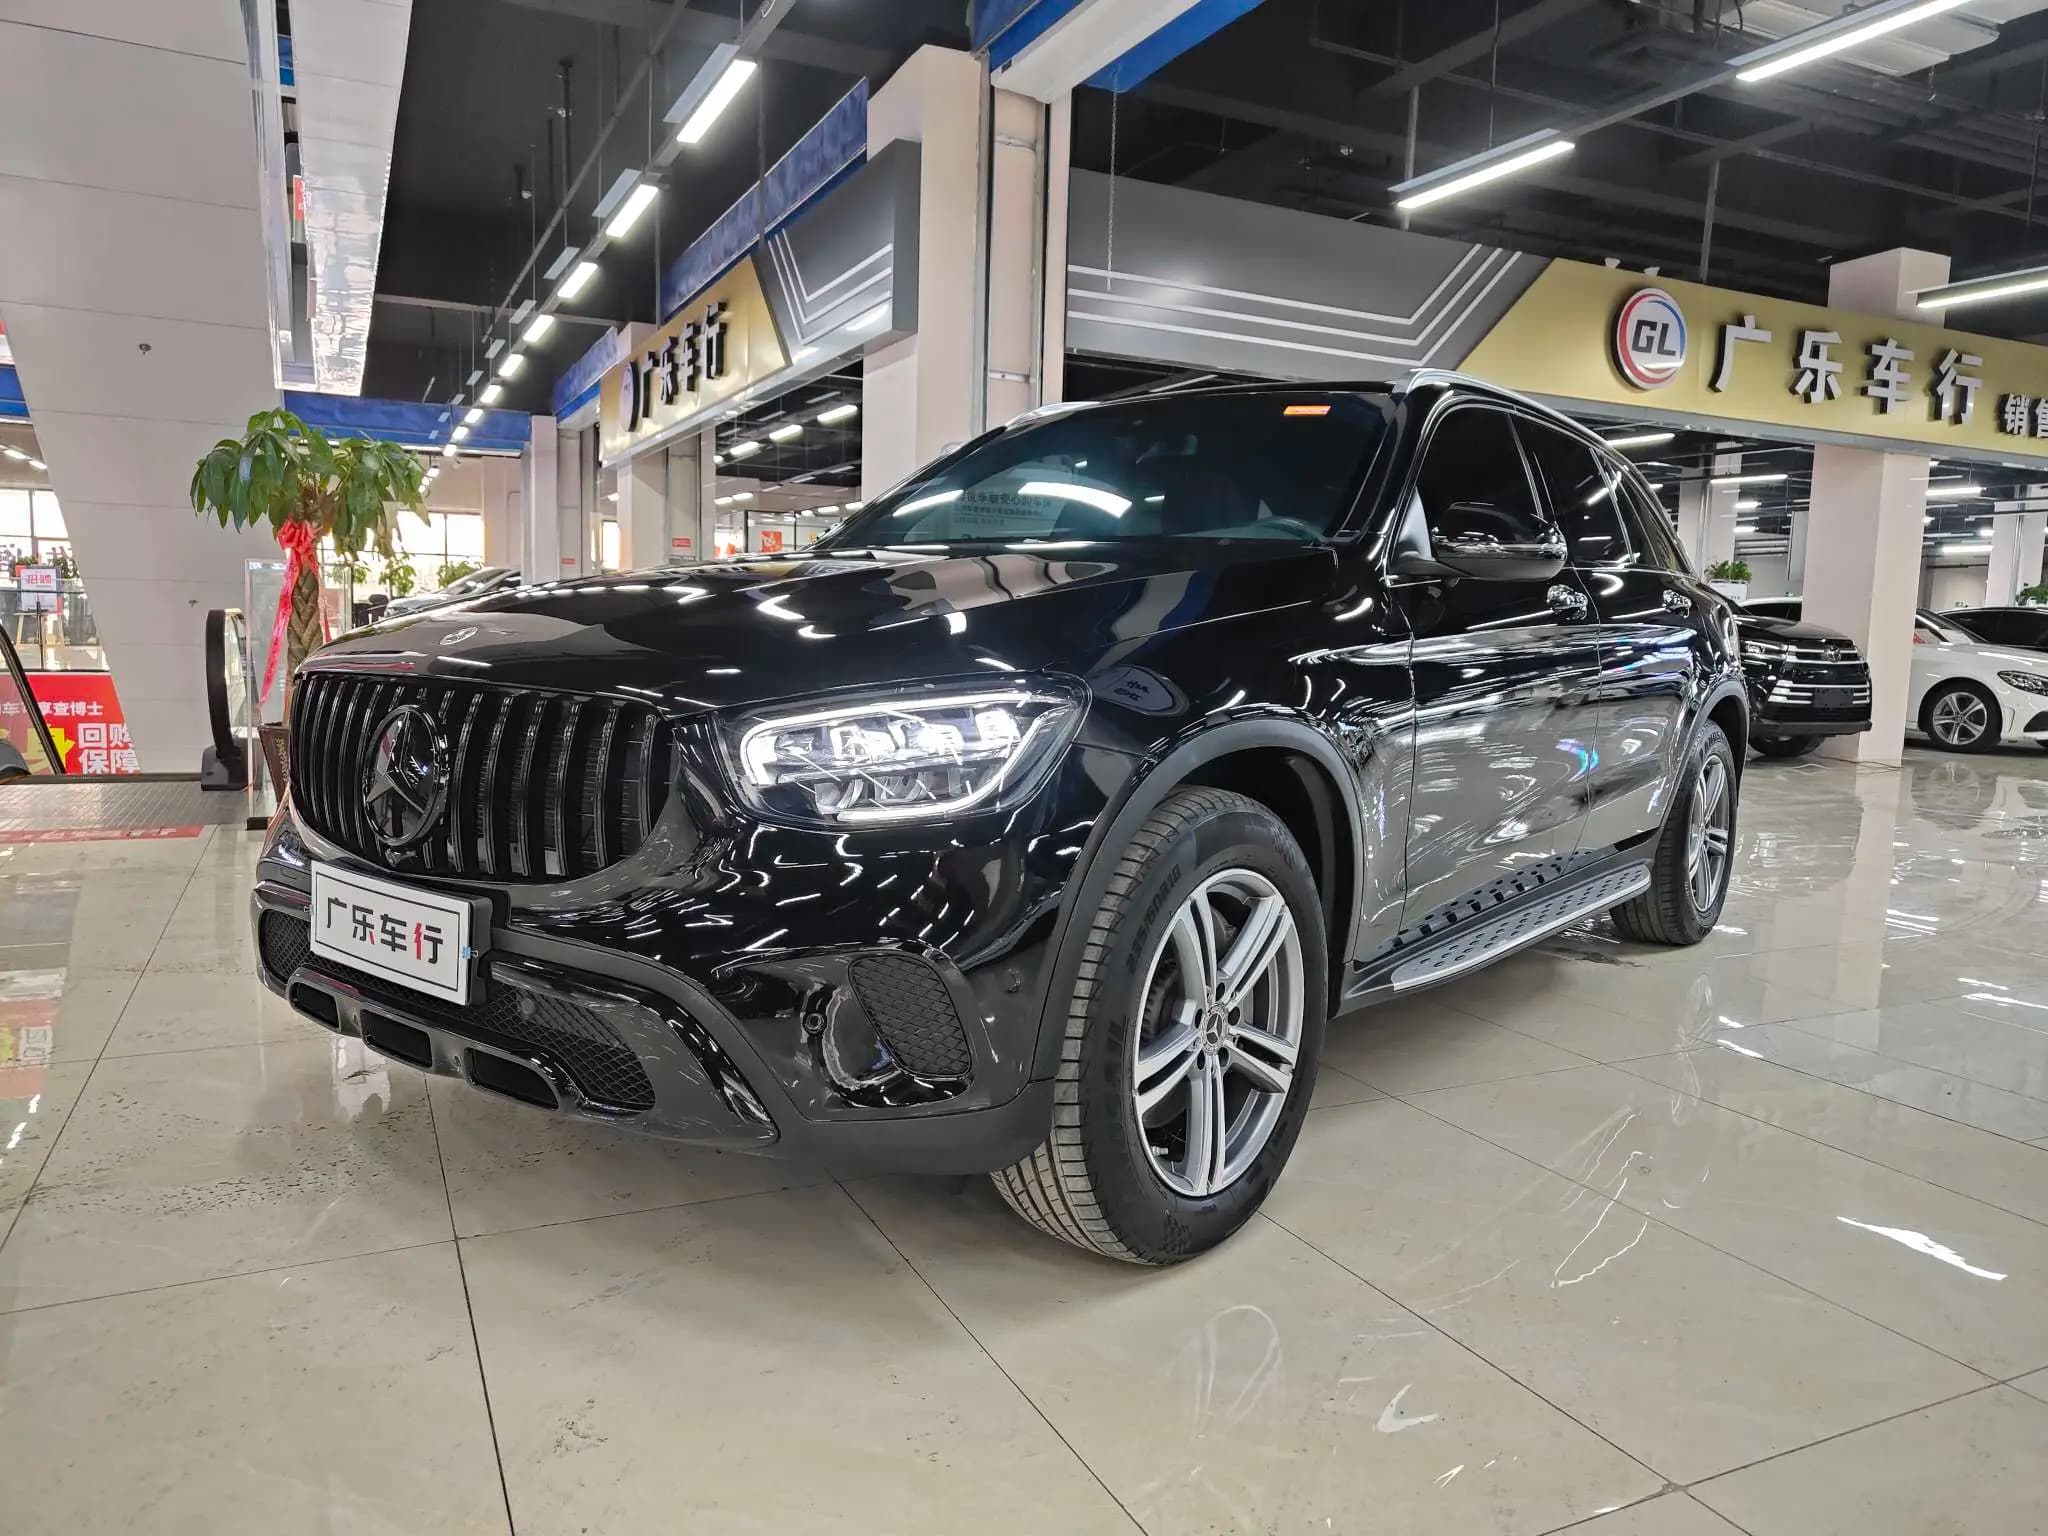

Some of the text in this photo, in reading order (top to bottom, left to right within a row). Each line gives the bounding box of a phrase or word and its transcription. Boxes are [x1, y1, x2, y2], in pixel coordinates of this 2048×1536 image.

[641, 302, 727, 418] 广乐车行
[1632, 319, 1676, 356] GL
[1709, 315, 1983, 424] 广乐车行
[327, 897, 443, 964] 广乐车行
